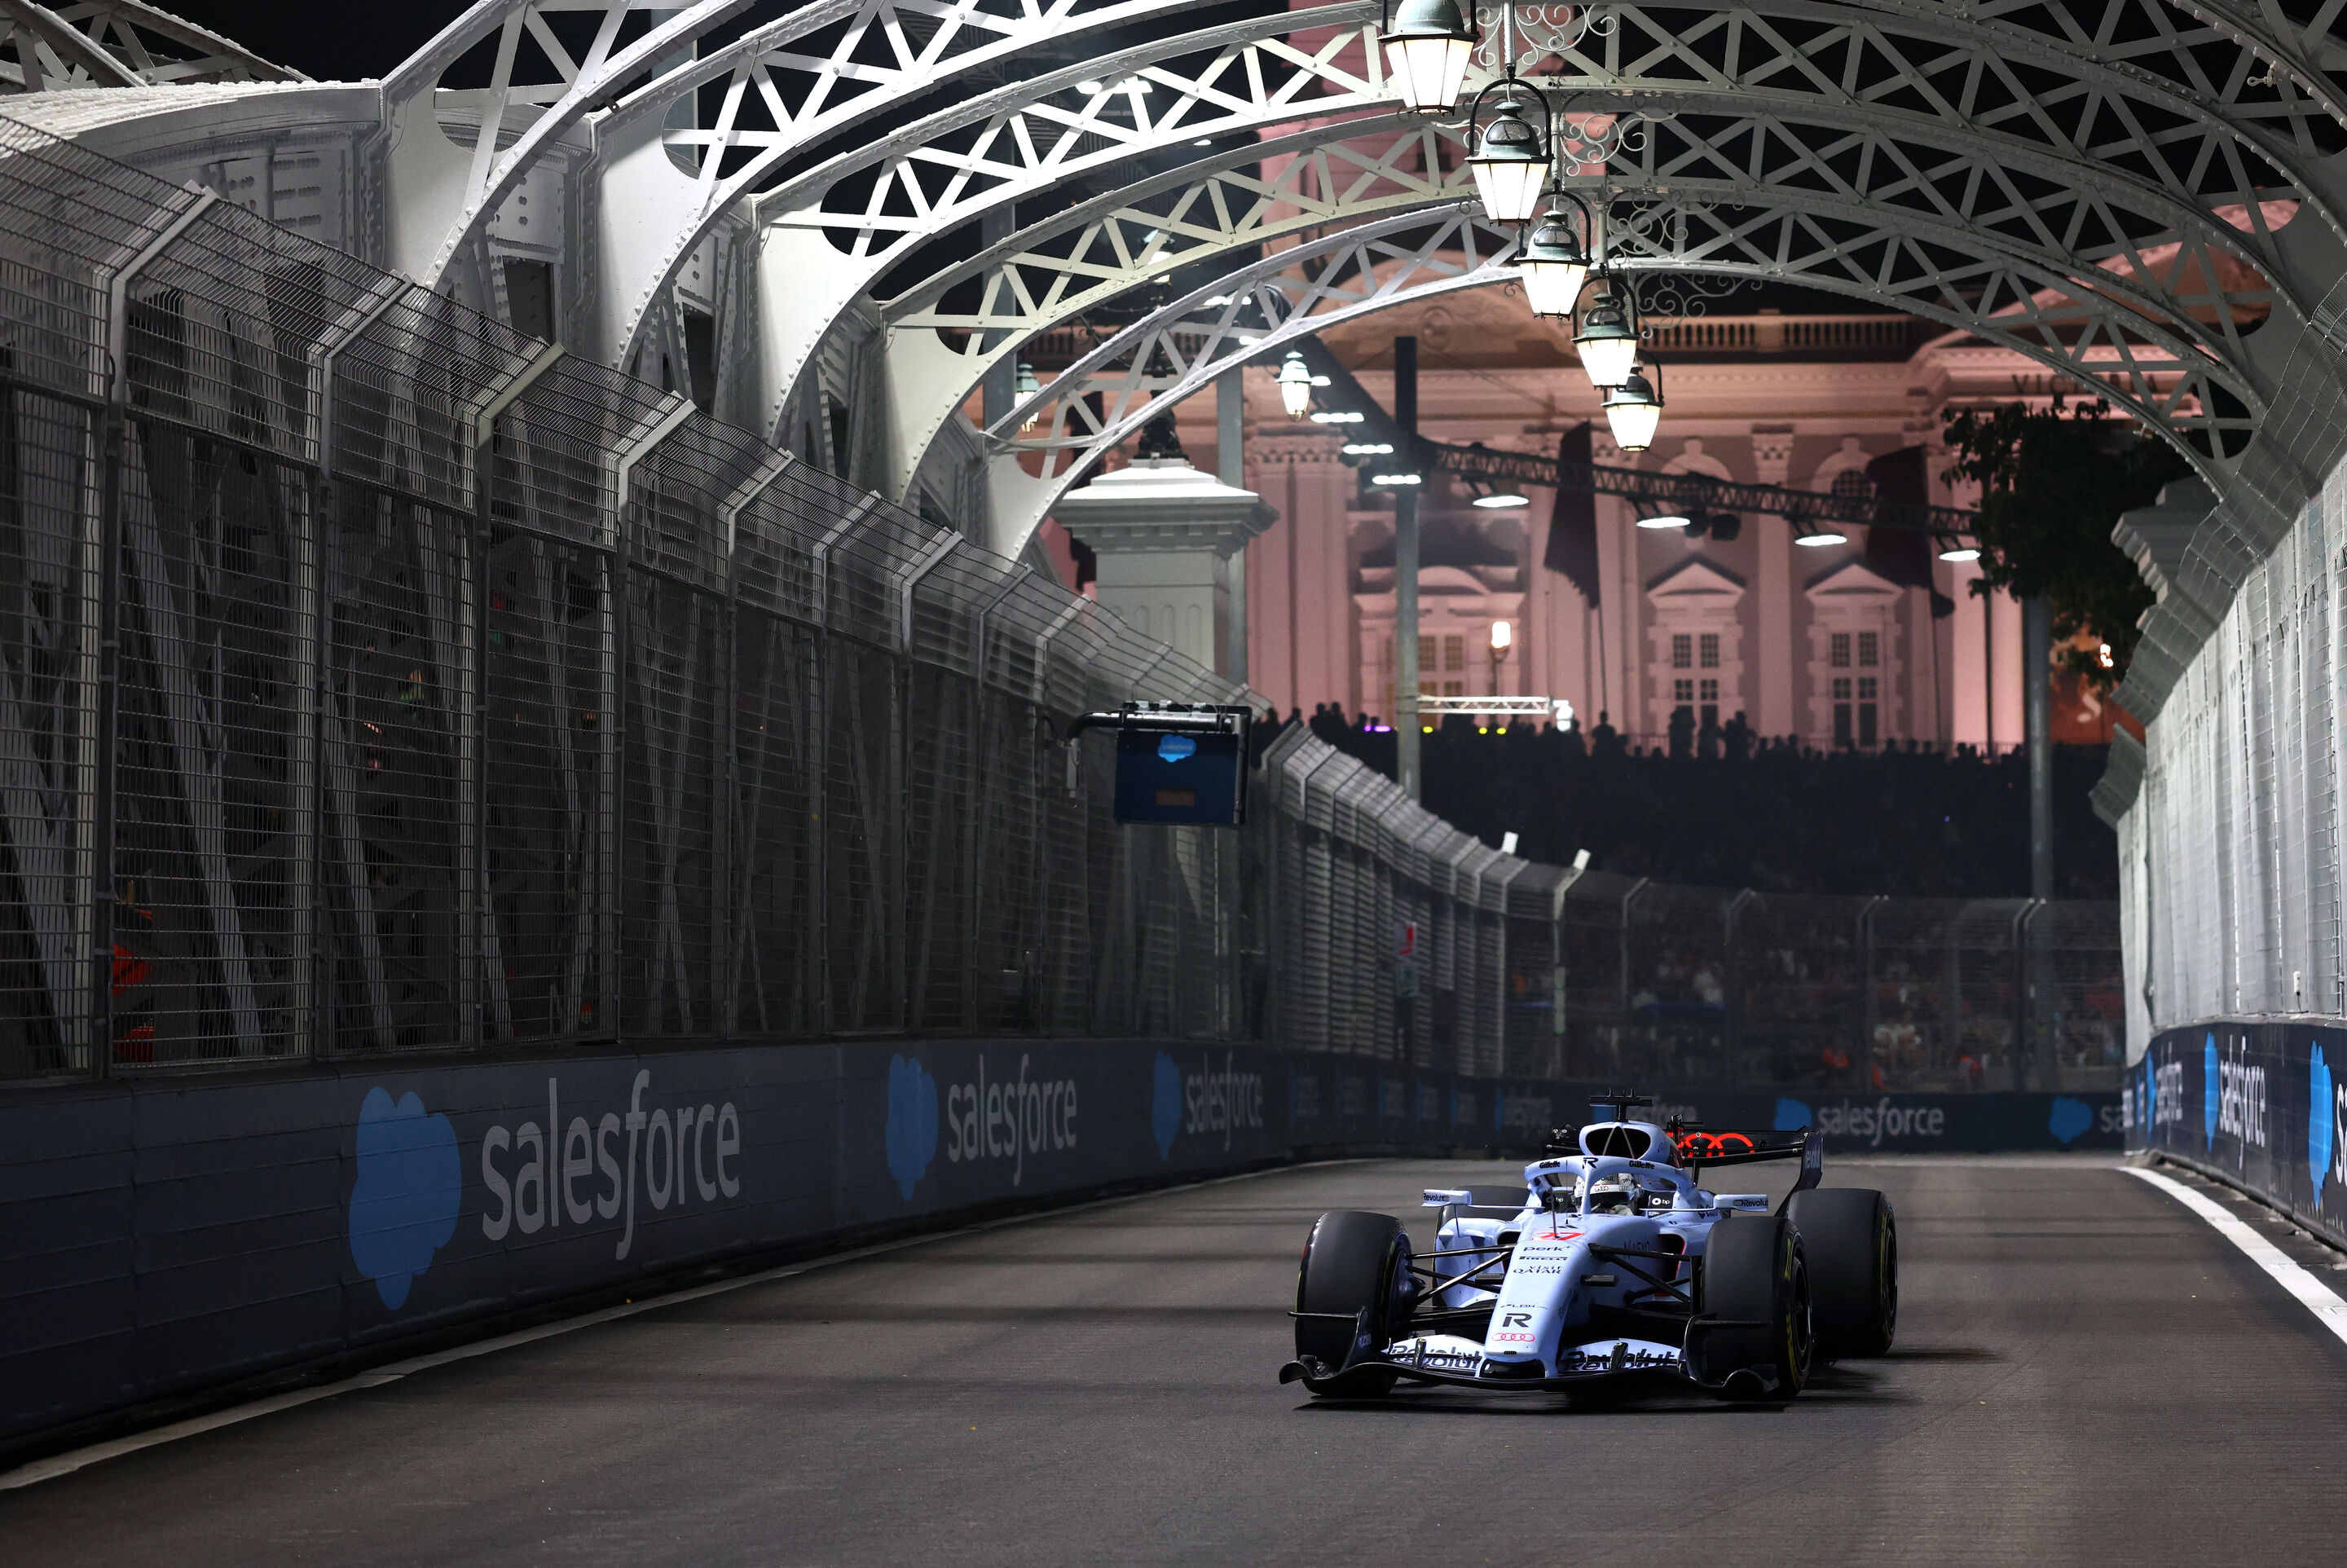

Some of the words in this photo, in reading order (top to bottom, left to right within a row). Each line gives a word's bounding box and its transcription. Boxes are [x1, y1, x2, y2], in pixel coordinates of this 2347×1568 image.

[948, 1052, 1077, 1187] salesforce
[1186, 1050, 1264, 1153] salesforce
[1817, 1097, 1944, 1147] salesforce
[482, 1068, 740, 1262] salesforce
[1539, 1161, 1561, 1169] Gillette
[1628, 1160, 1655, 1169] Gillette
